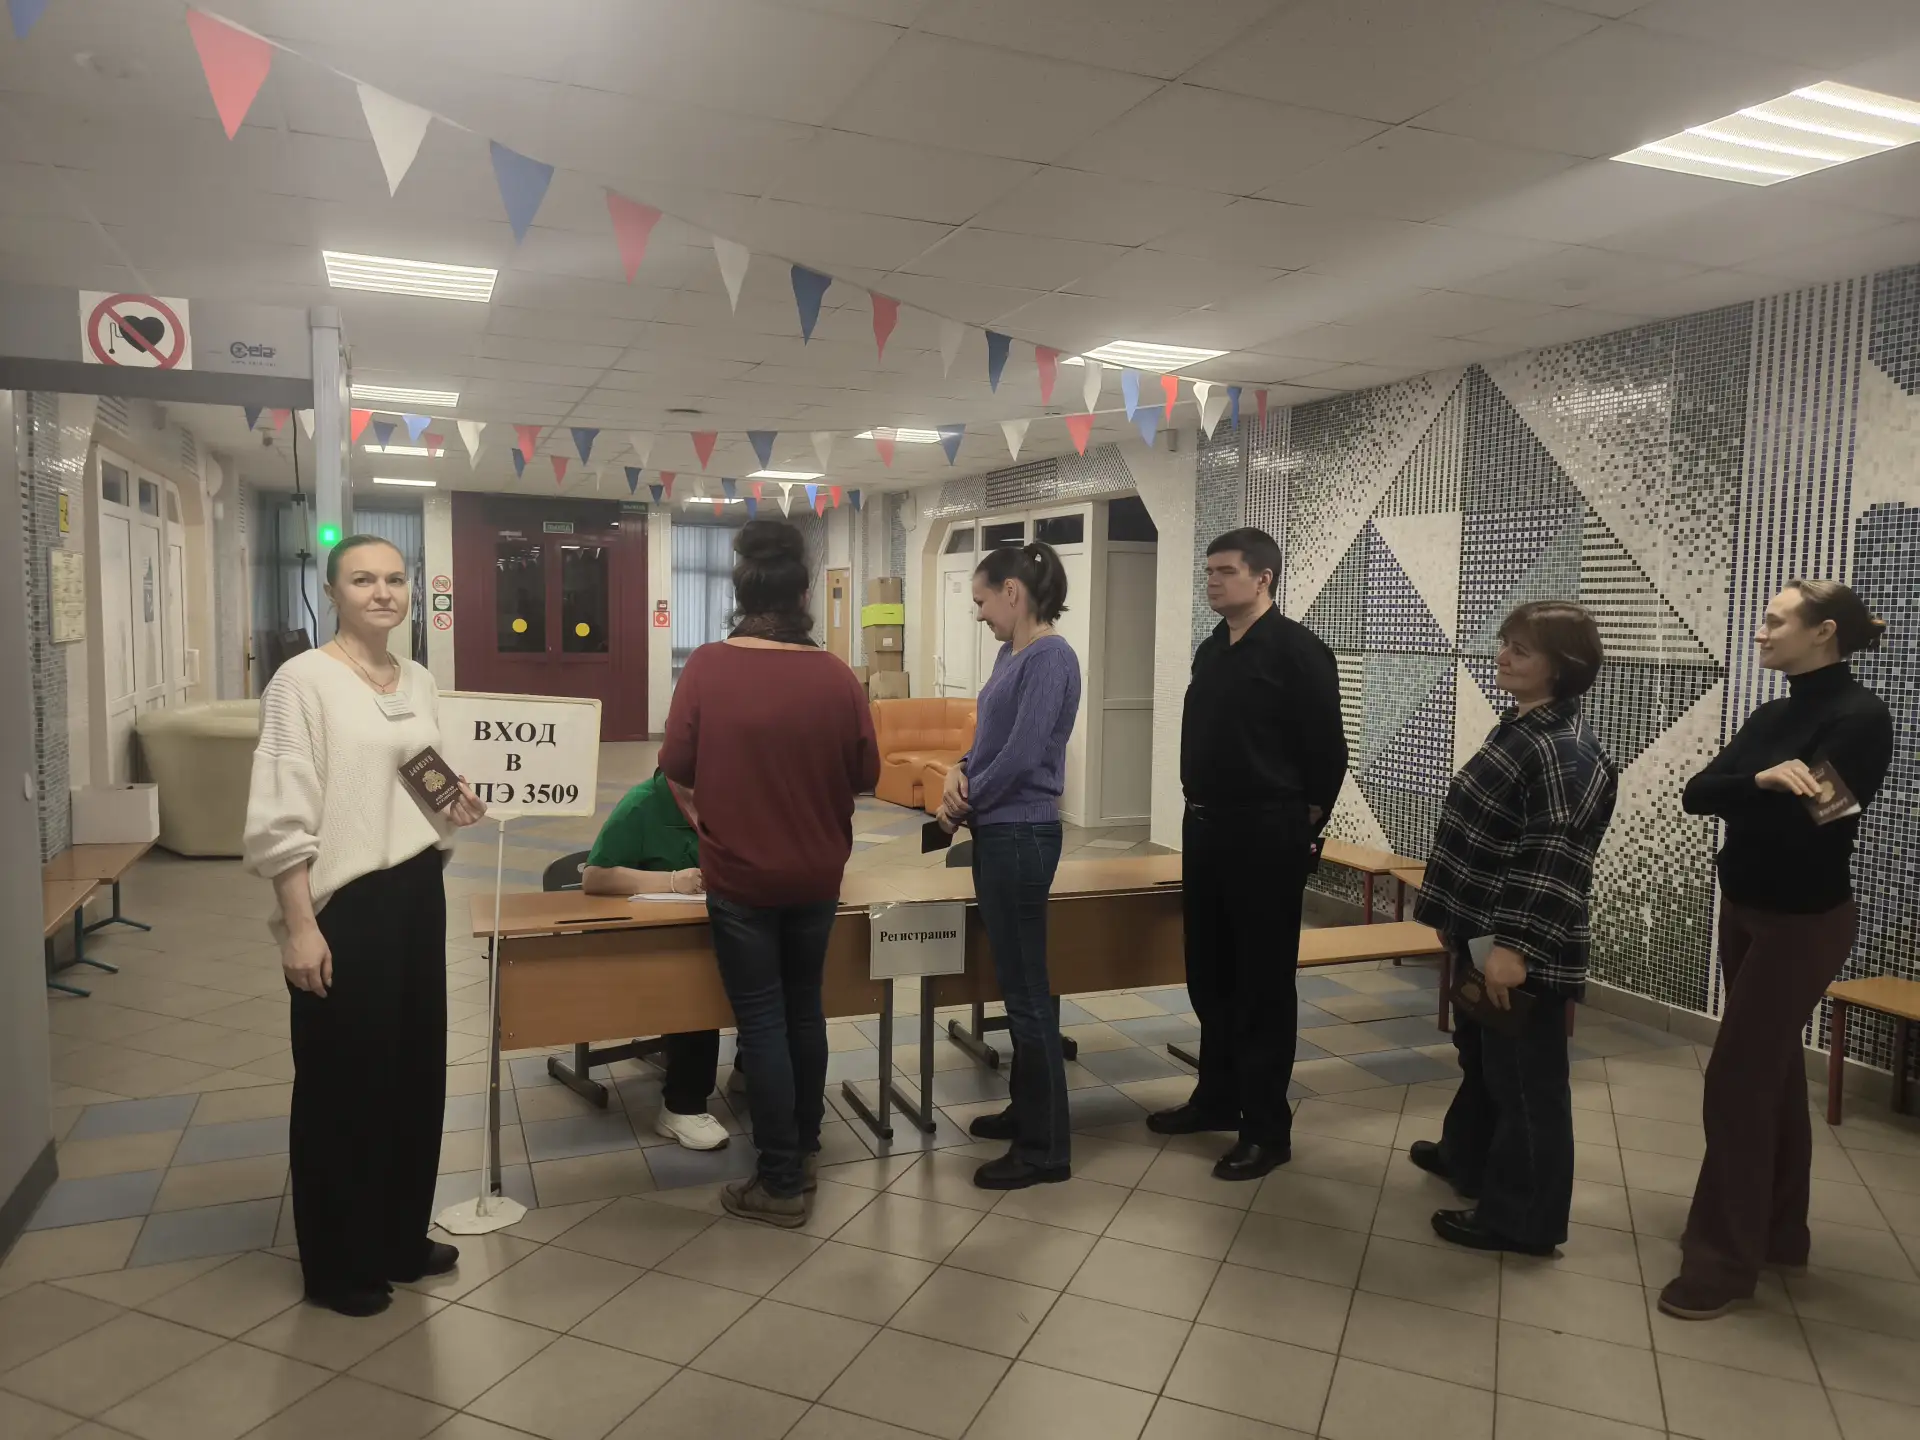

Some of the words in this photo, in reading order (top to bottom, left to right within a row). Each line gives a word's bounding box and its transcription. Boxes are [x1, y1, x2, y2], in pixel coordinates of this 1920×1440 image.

[473, 720, 557, 748] ВХОД
[505, 753, 522, 771] В
[467, 782, 515, 804] ПЭ
[522, 783, 579, 804] 3509
[880, 930, 957, 943] Регистрация
